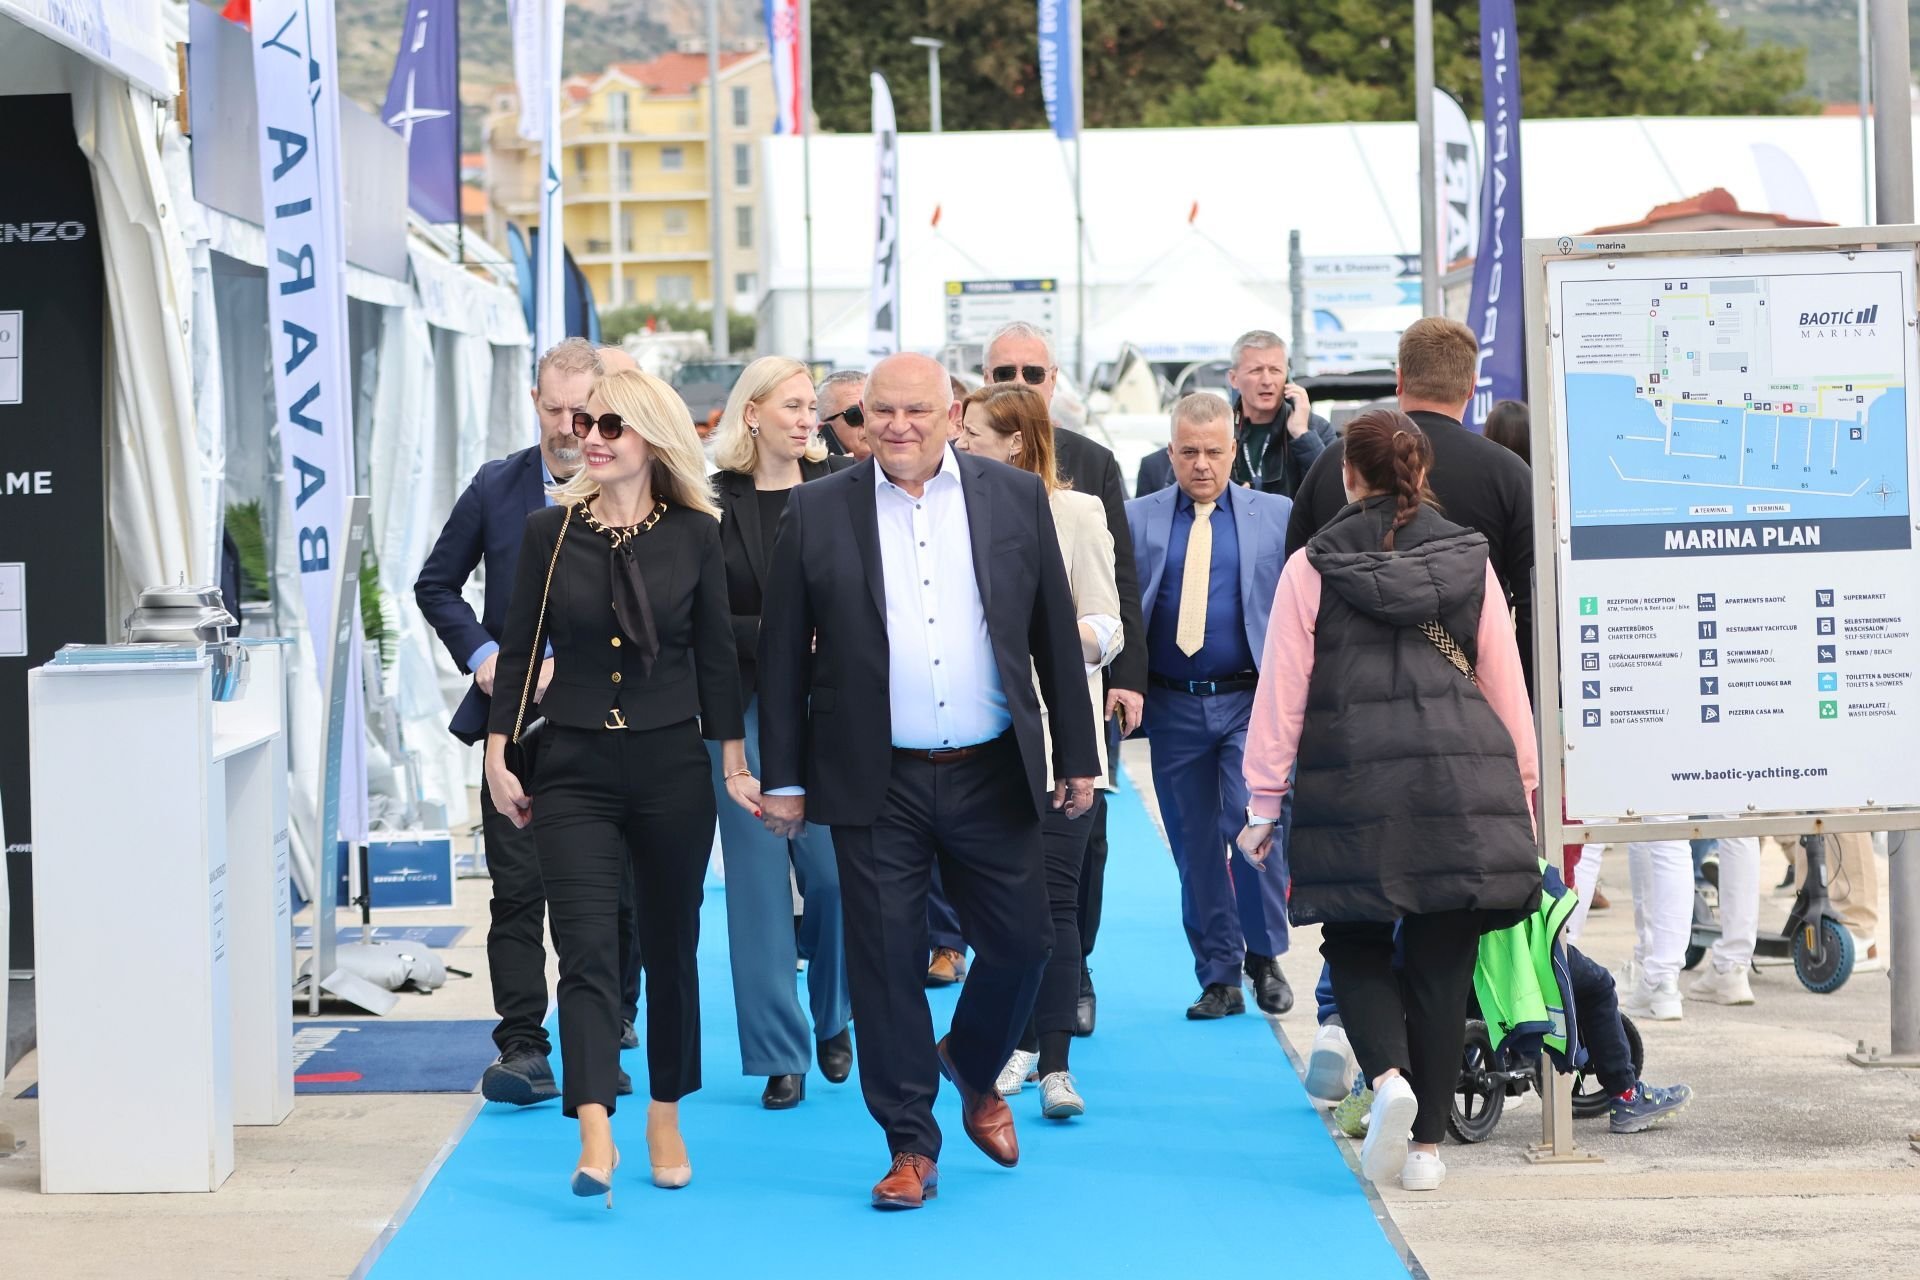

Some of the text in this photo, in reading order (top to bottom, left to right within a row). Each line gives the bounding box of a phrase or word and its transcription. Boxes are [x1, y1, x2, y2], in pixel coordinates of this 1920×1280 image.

[0, 221, 87, 243] NZO
[1800, 309, 1854, 326] BAOTIĆ
[1801, 329, 1876, 339] MARINA
[0, 471, 53, 495] ME
[1664, 525, 1821, 550] MARINA PLAN
[1610, 709, 1665, 717] BOOTSTANKSTELLE
[1671, 766, 1828, 782] www.baotic-yachting.com
